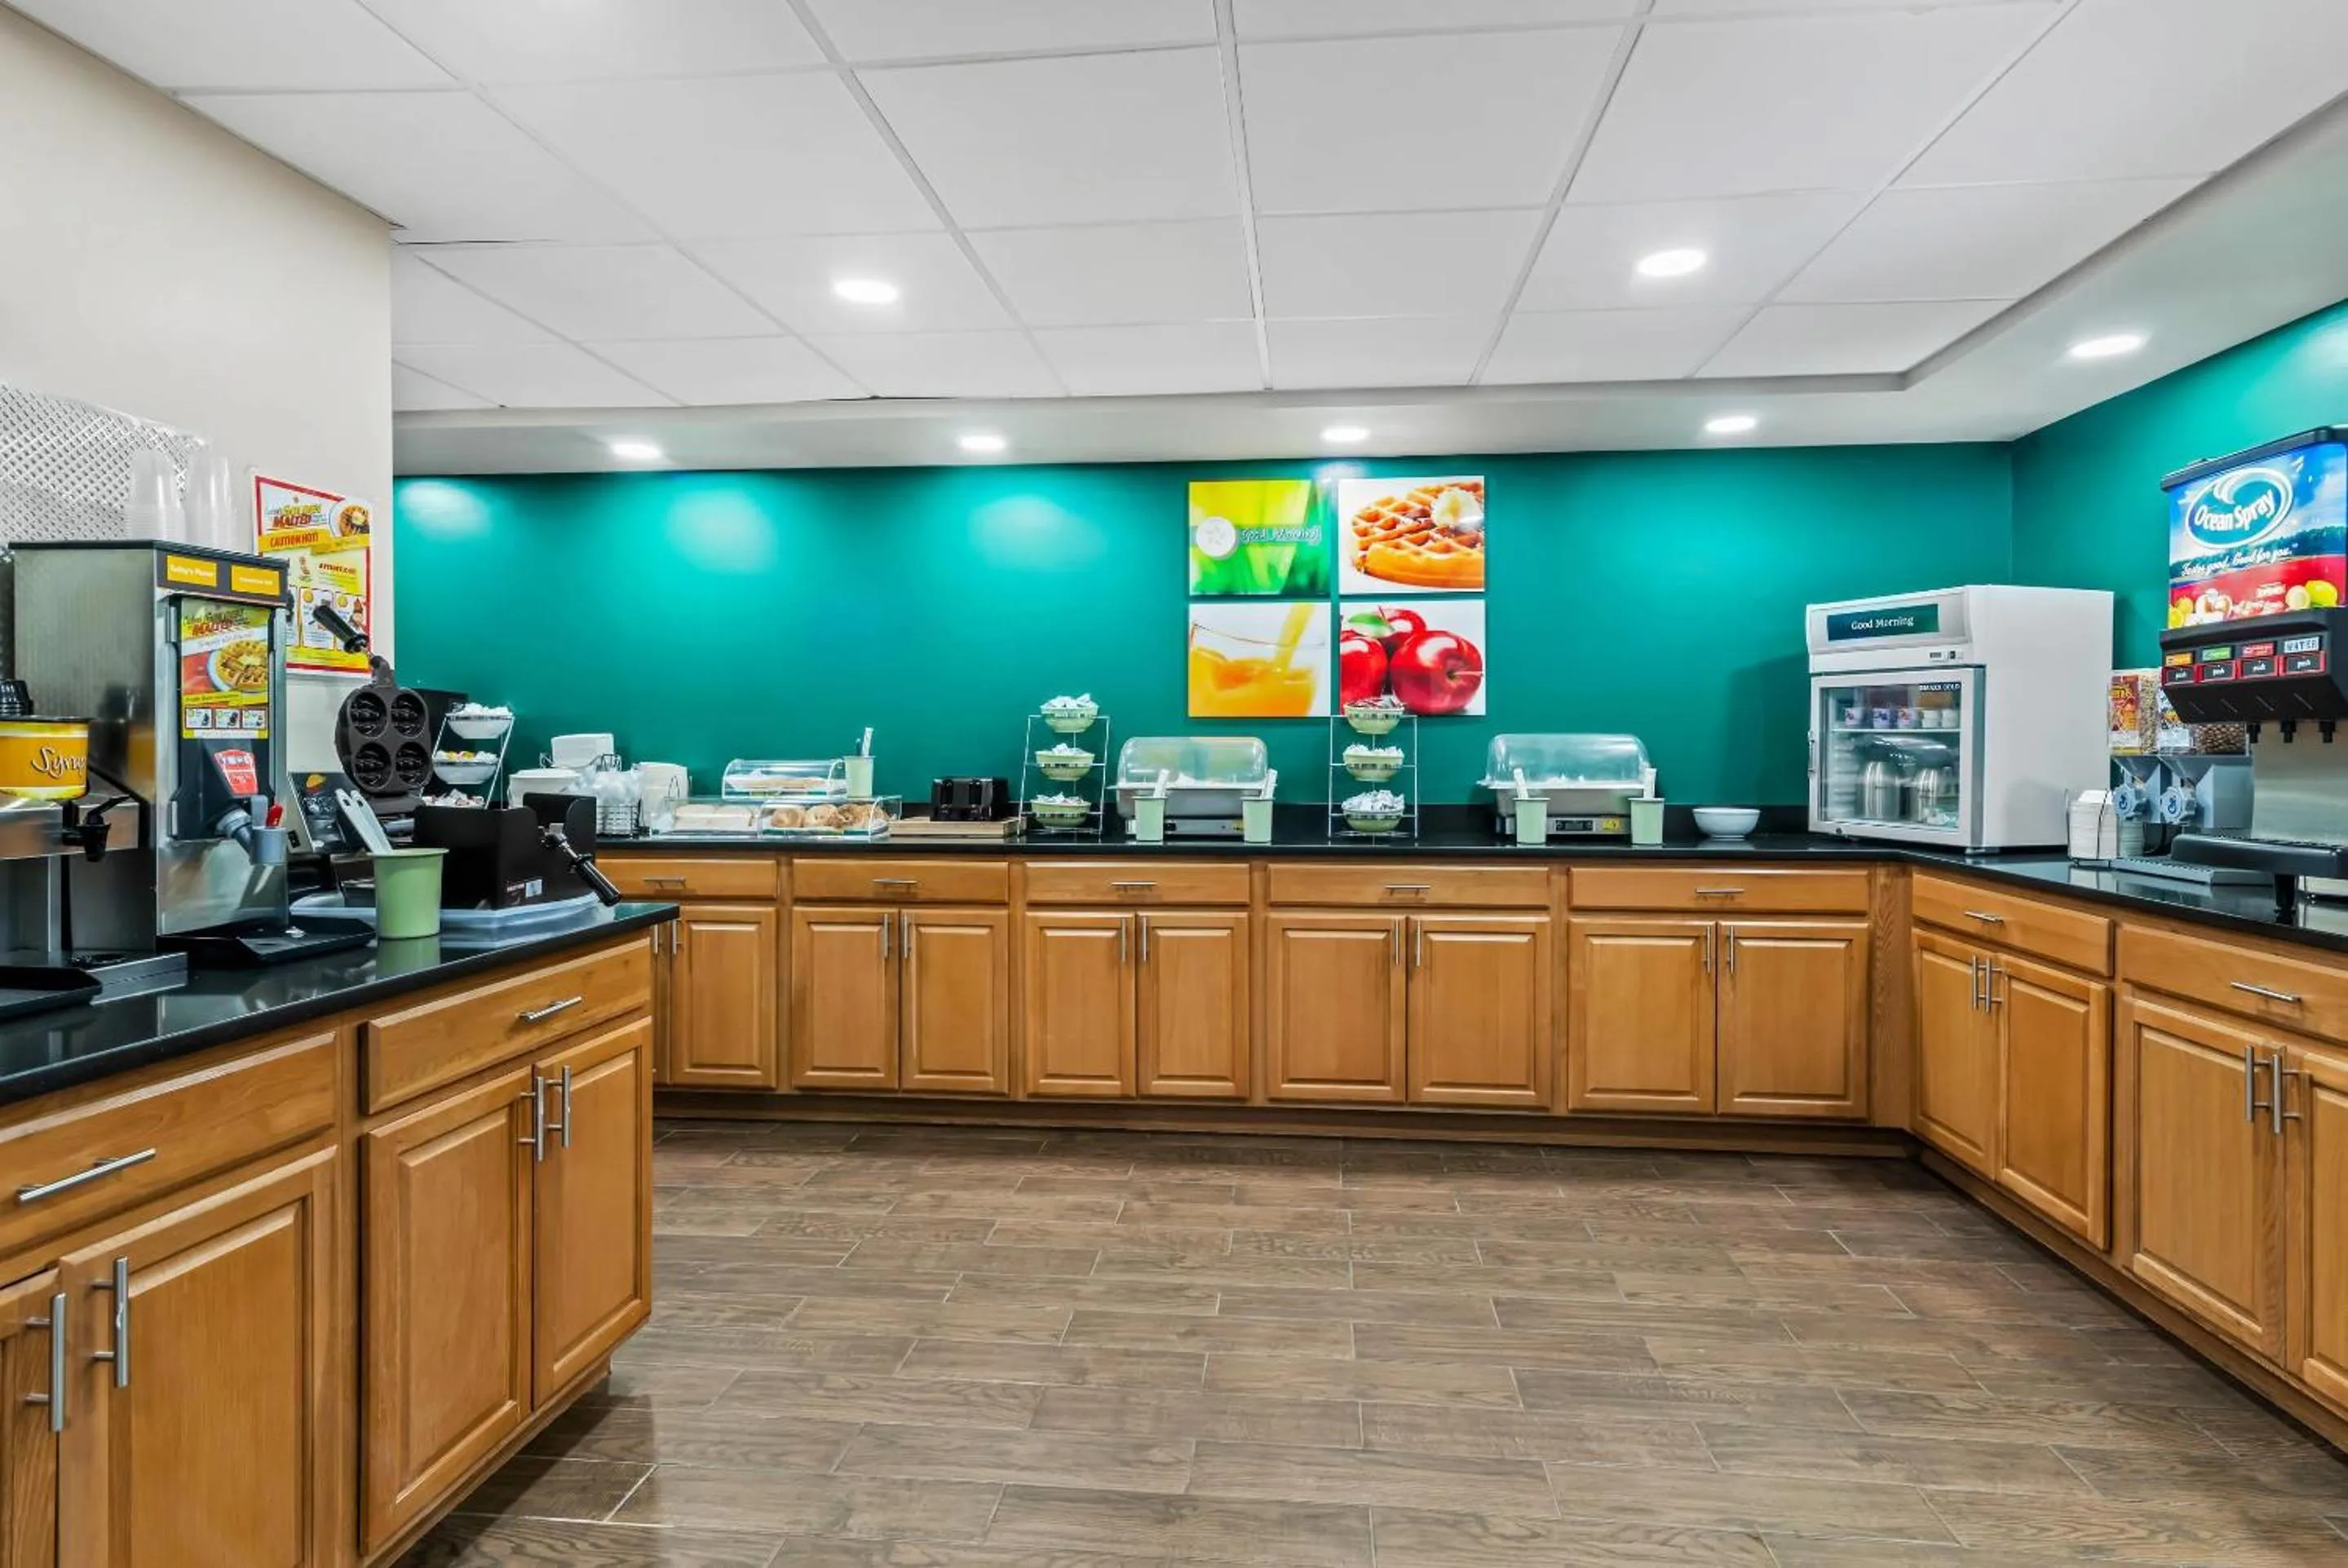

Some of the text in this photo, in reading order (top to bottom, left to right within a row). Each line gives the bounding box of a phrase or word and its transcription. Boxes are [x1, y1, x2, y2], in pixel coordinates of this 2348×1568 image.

[2194, 488, 2275, 532] Ocean Spray
[1851, 616, 1915, 630] Good Morning
[2285, 639, 2318, 653] WATER
